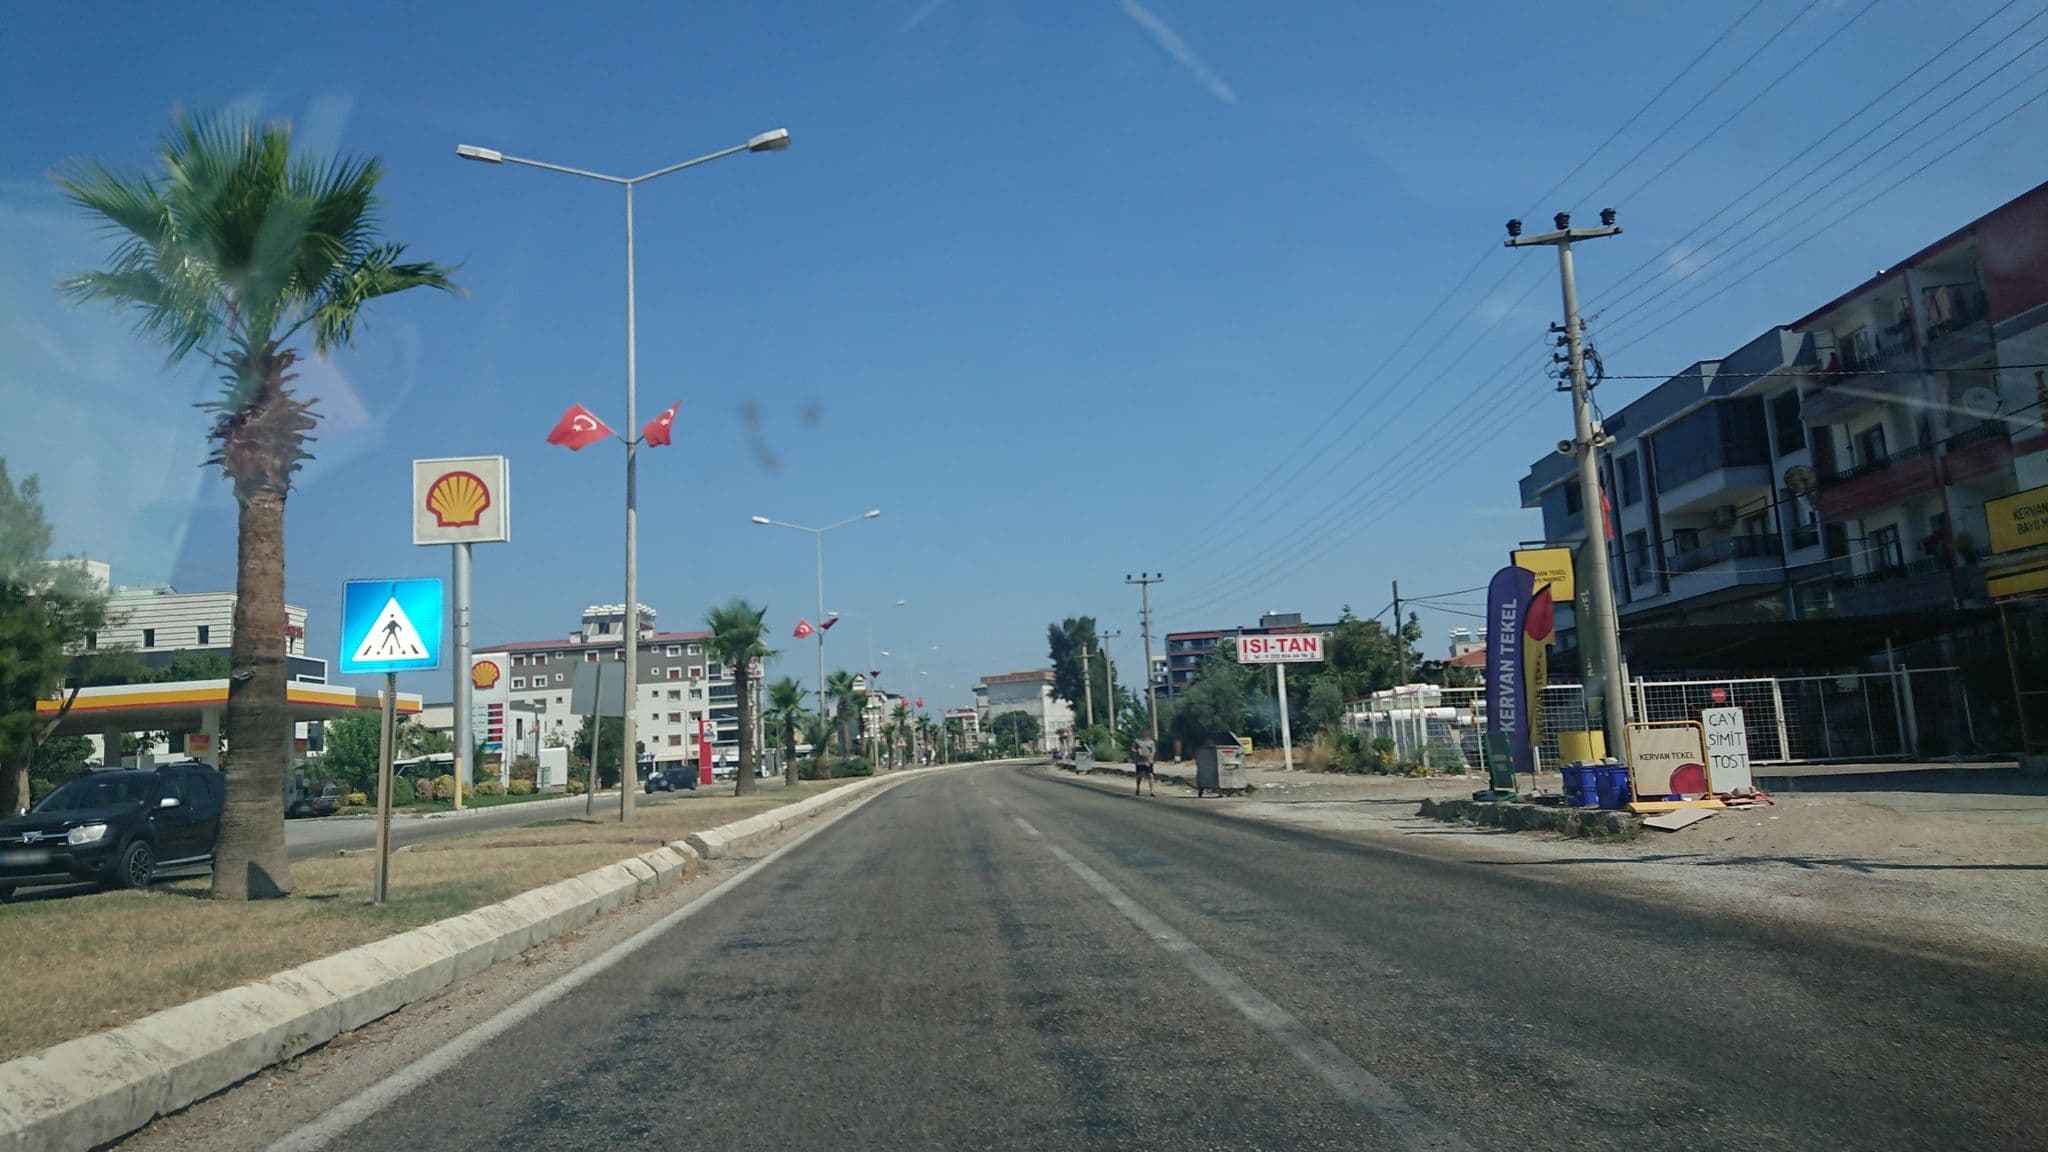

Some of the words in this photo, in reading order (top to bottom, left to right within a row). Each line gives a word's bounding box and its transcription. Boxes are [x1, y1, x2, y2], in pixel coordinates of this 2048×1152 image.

[1500, 598, 1517, 656] TEKEL
[1242, 637, 1317, 654] ISI-TAN
[1499, 660, 1516, 732] KERVAN
[1639, 752, 1671, 761] KERVAN
[1671, 751, 1696, 760] TEKEL
[1710, 753, 1747, 768] TOST
